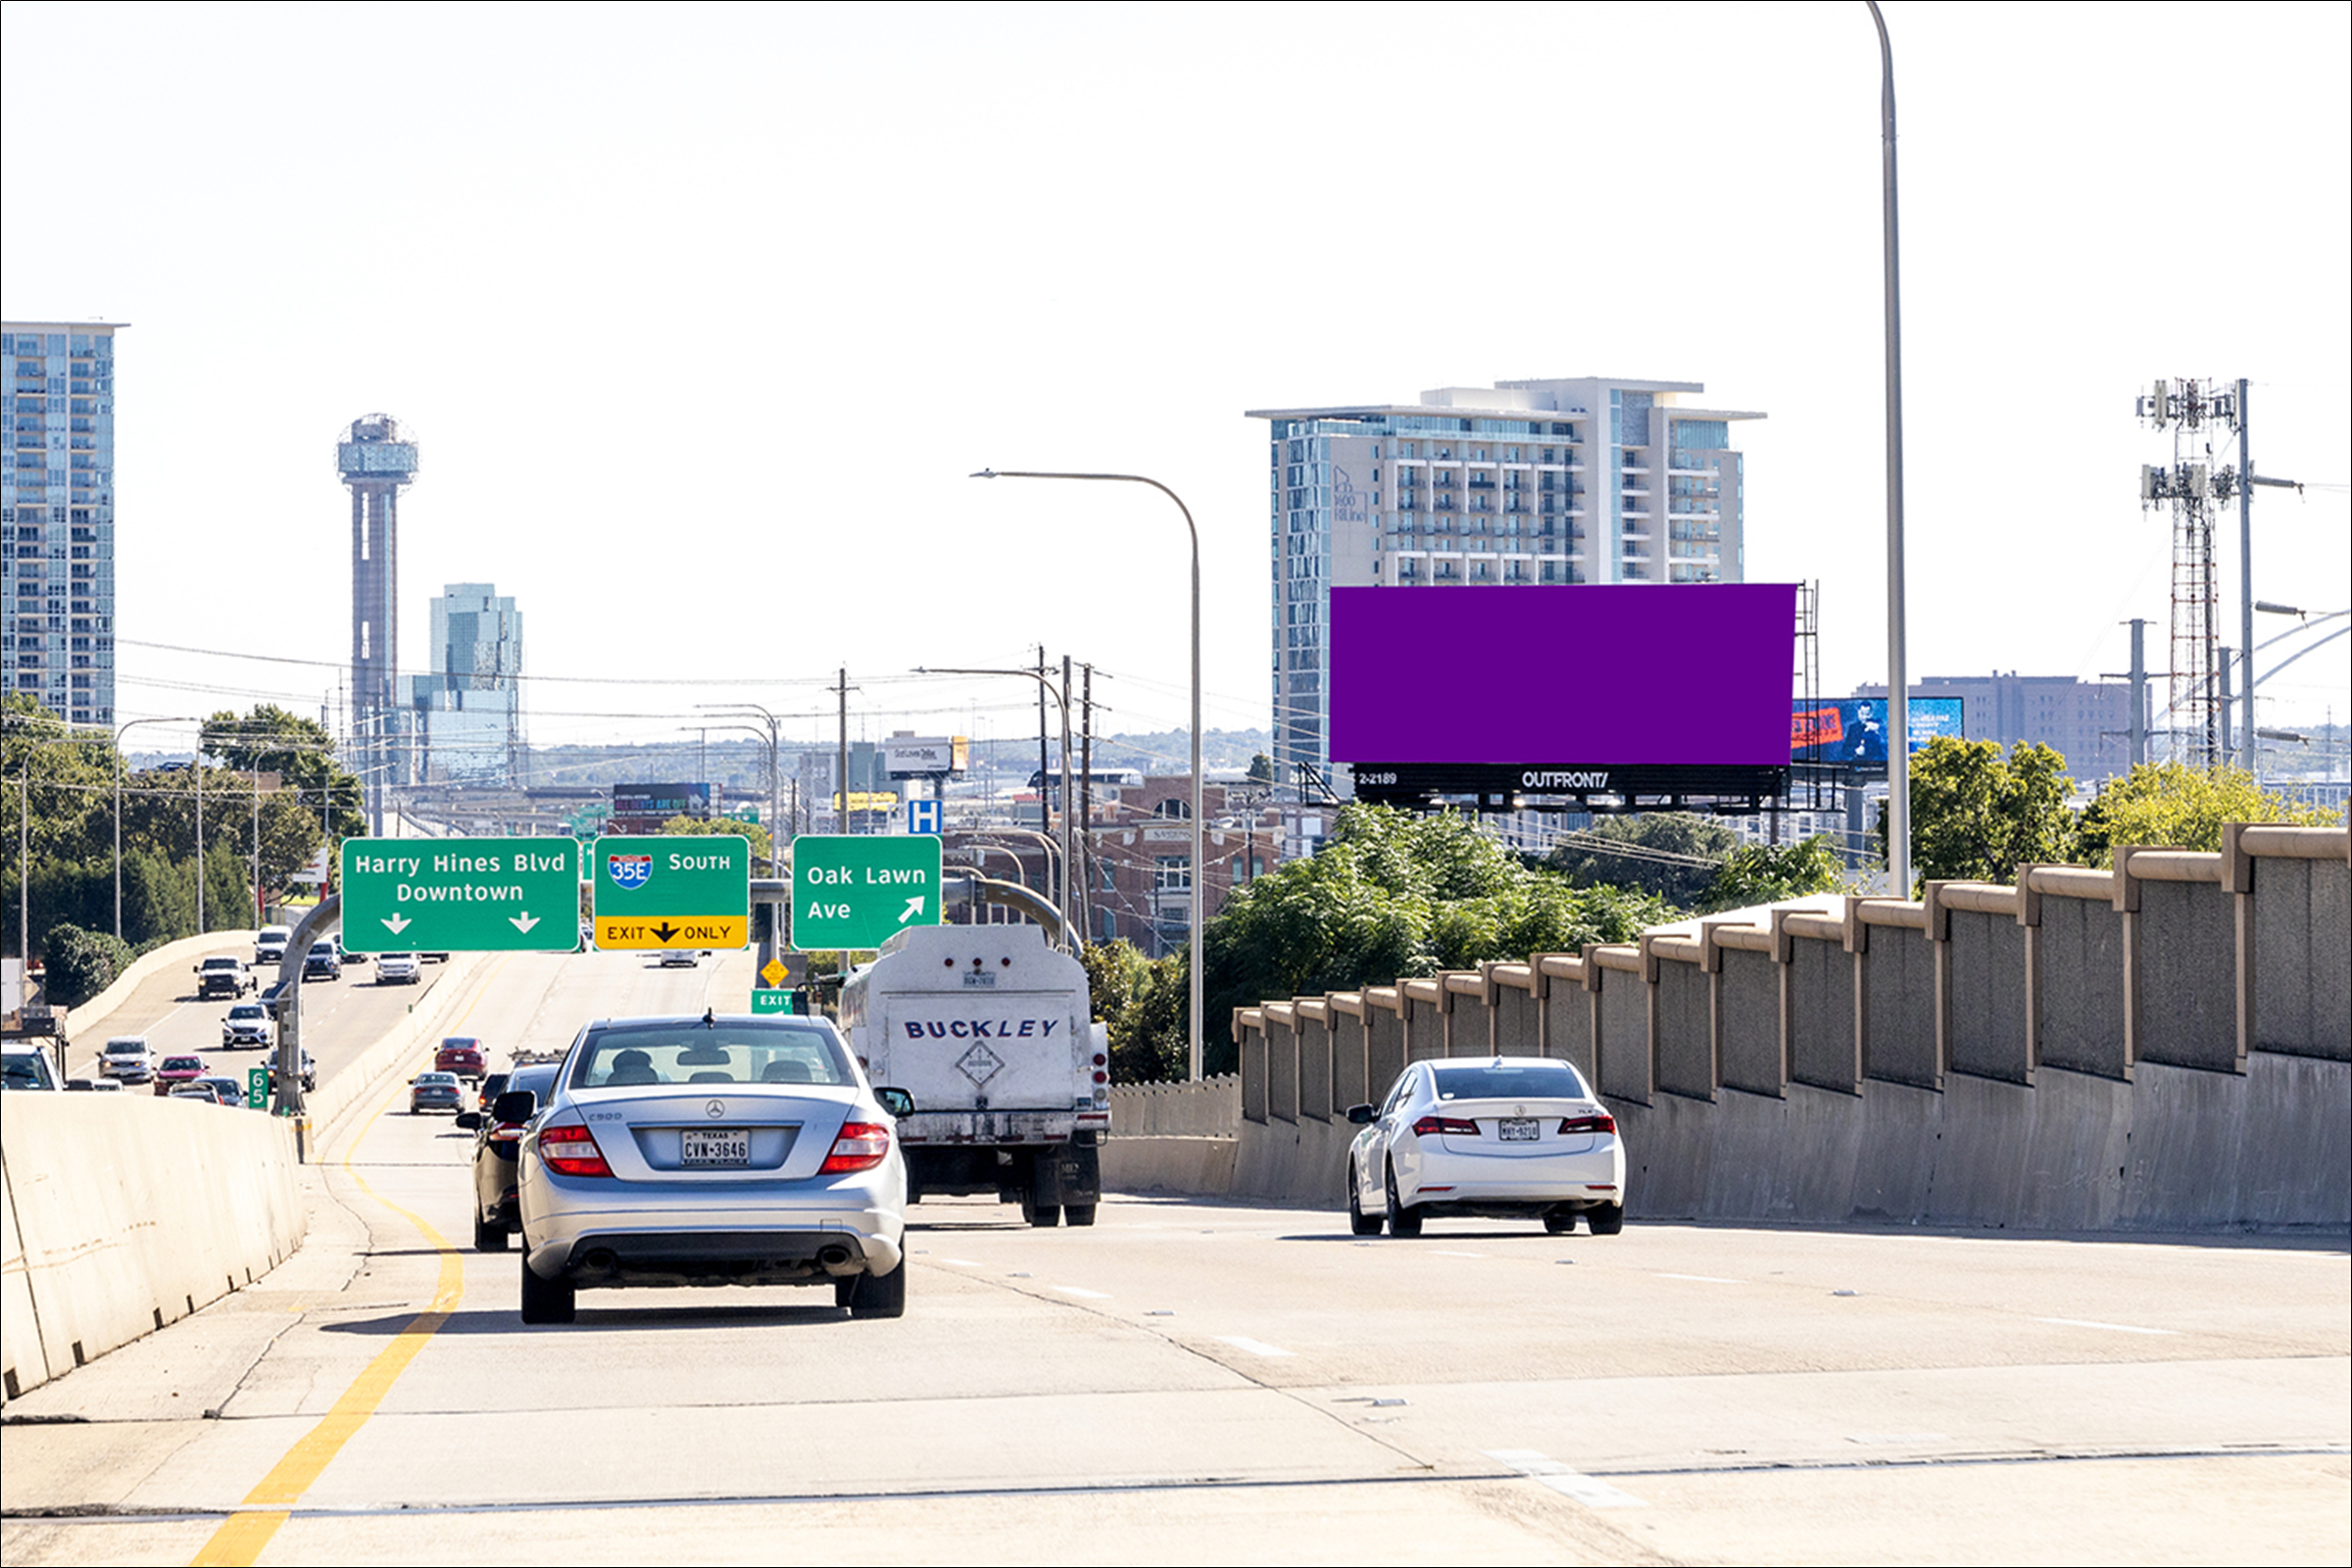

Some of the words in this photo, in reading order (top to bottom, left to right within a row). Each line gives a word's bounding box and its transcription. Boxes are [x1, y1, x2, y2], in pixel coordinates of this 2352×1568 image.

[1359, 772, 1397, 785] 2-2189
[913, 802, 938, 832] H
[356, 854, 420, 878] Harry
[433, 853, 501, 872] Hines
[514, 853, 564, 872] Blvd
[612, 862, 647, 880] 35E
[808, 865, 853, 885] Oak
[866, 866, 926, 885] Lawn
[397, 883, 523, 902] Downtown
[808, 901, 851, 919] Ave
[607, 926, 646, 941] EXIT
[683, 925, 731, 941] ONLY
[760, 994, 791, 1006] EXIT
[904, 1019, 1058, 1040] BUCKLEY
